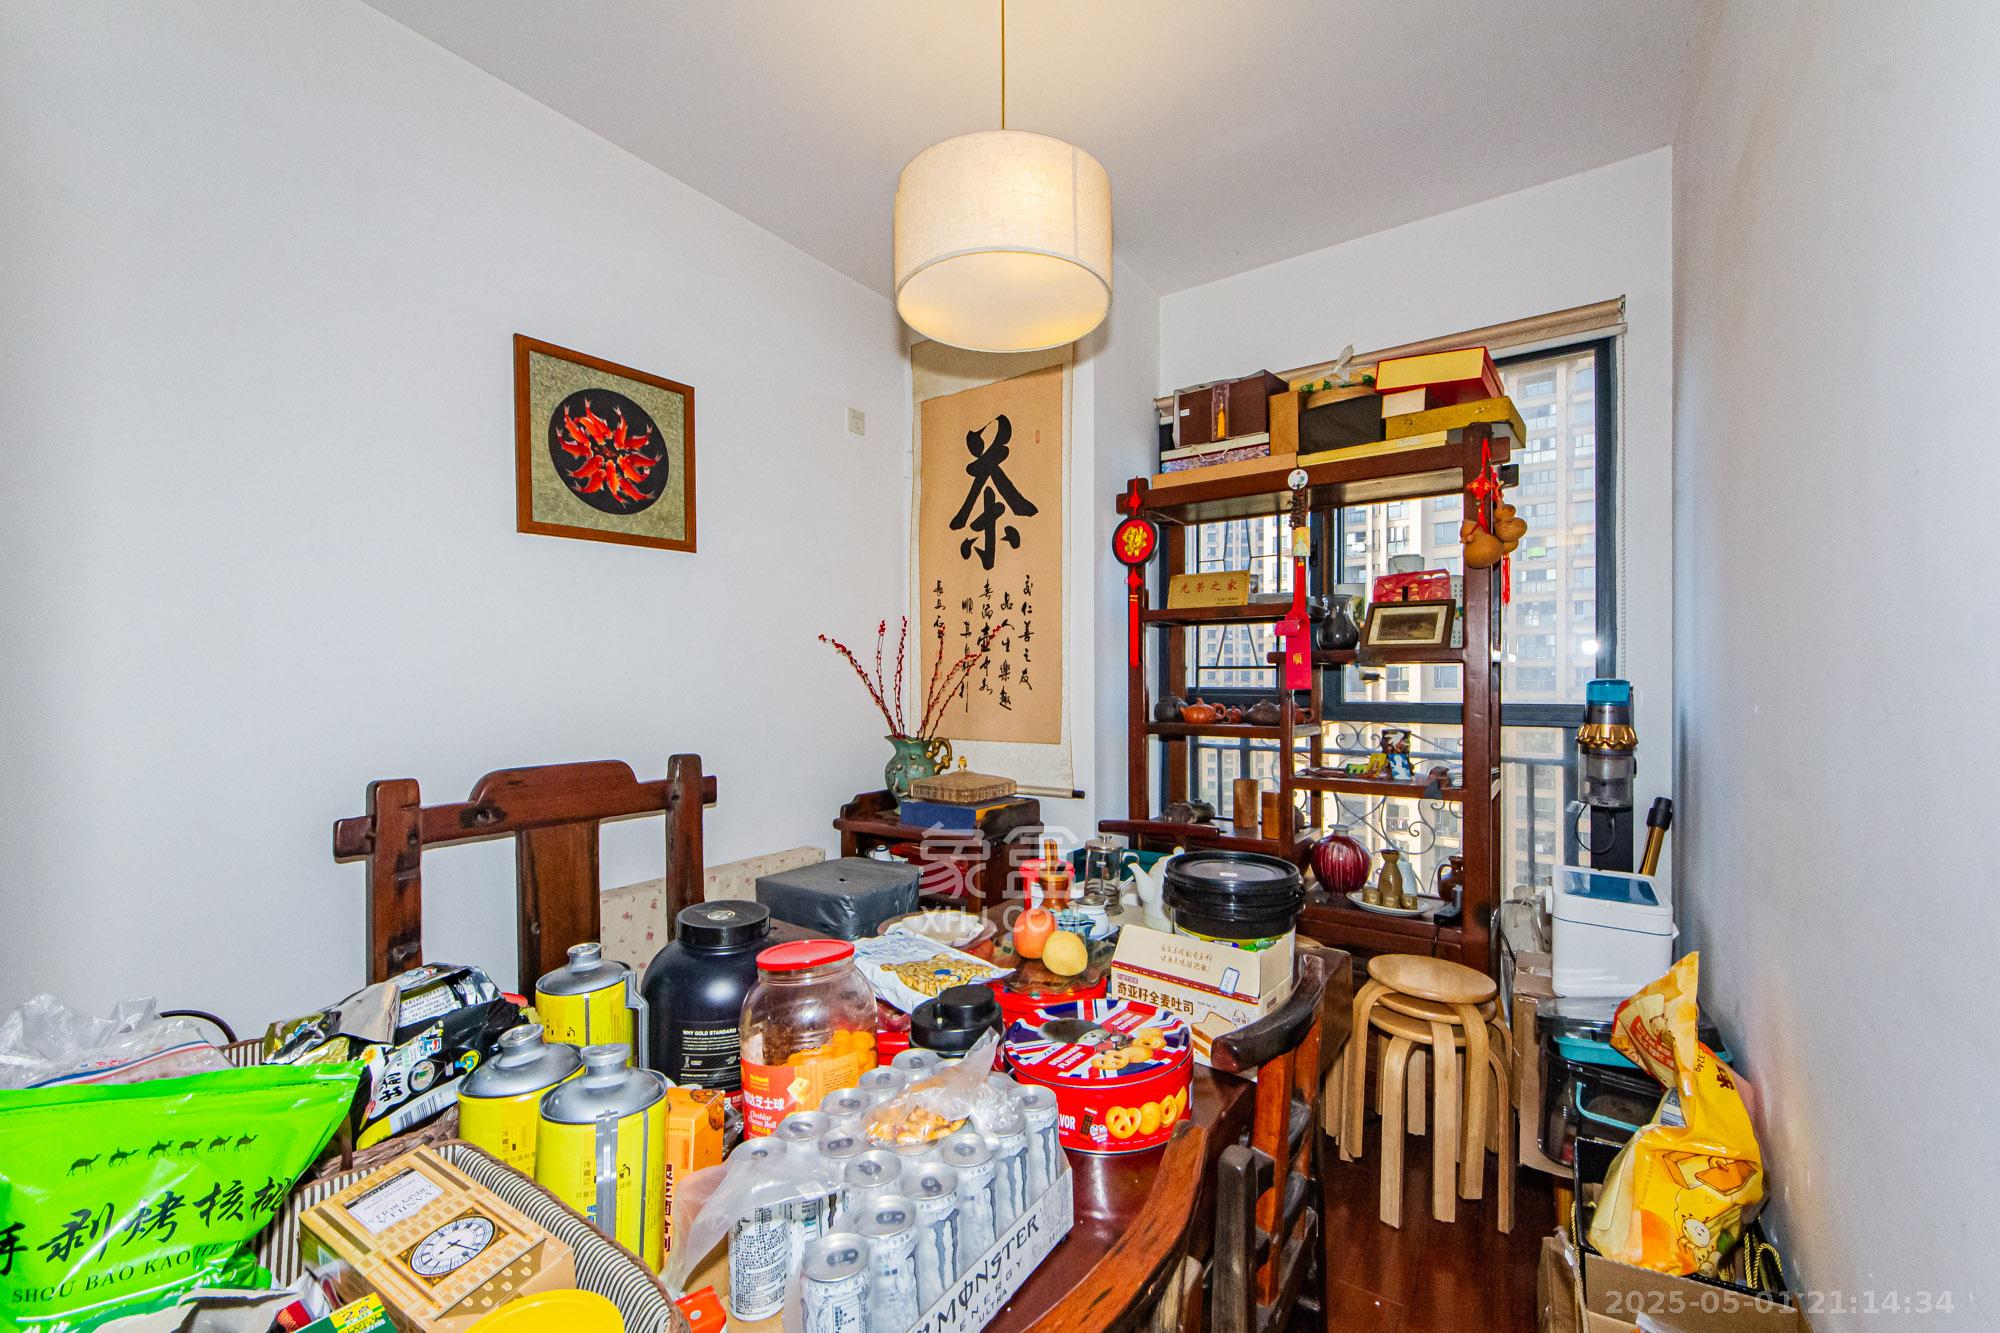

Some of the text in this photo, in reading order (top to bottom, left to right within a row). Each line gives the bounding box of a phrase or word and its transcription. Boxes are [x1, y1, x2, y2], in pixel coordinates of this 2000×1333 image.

[948, 413, 1039, 571] 茶
[1117, 982, 1194, 1016] 奇亚籽全麦吐司
[709, 1027, 737, 1036] STANDARD
[13, 1281, 74, 1302] SHOU
[85, 1266, 134, 1291] BAO
[144, 1250, 190, 1275] KAO
